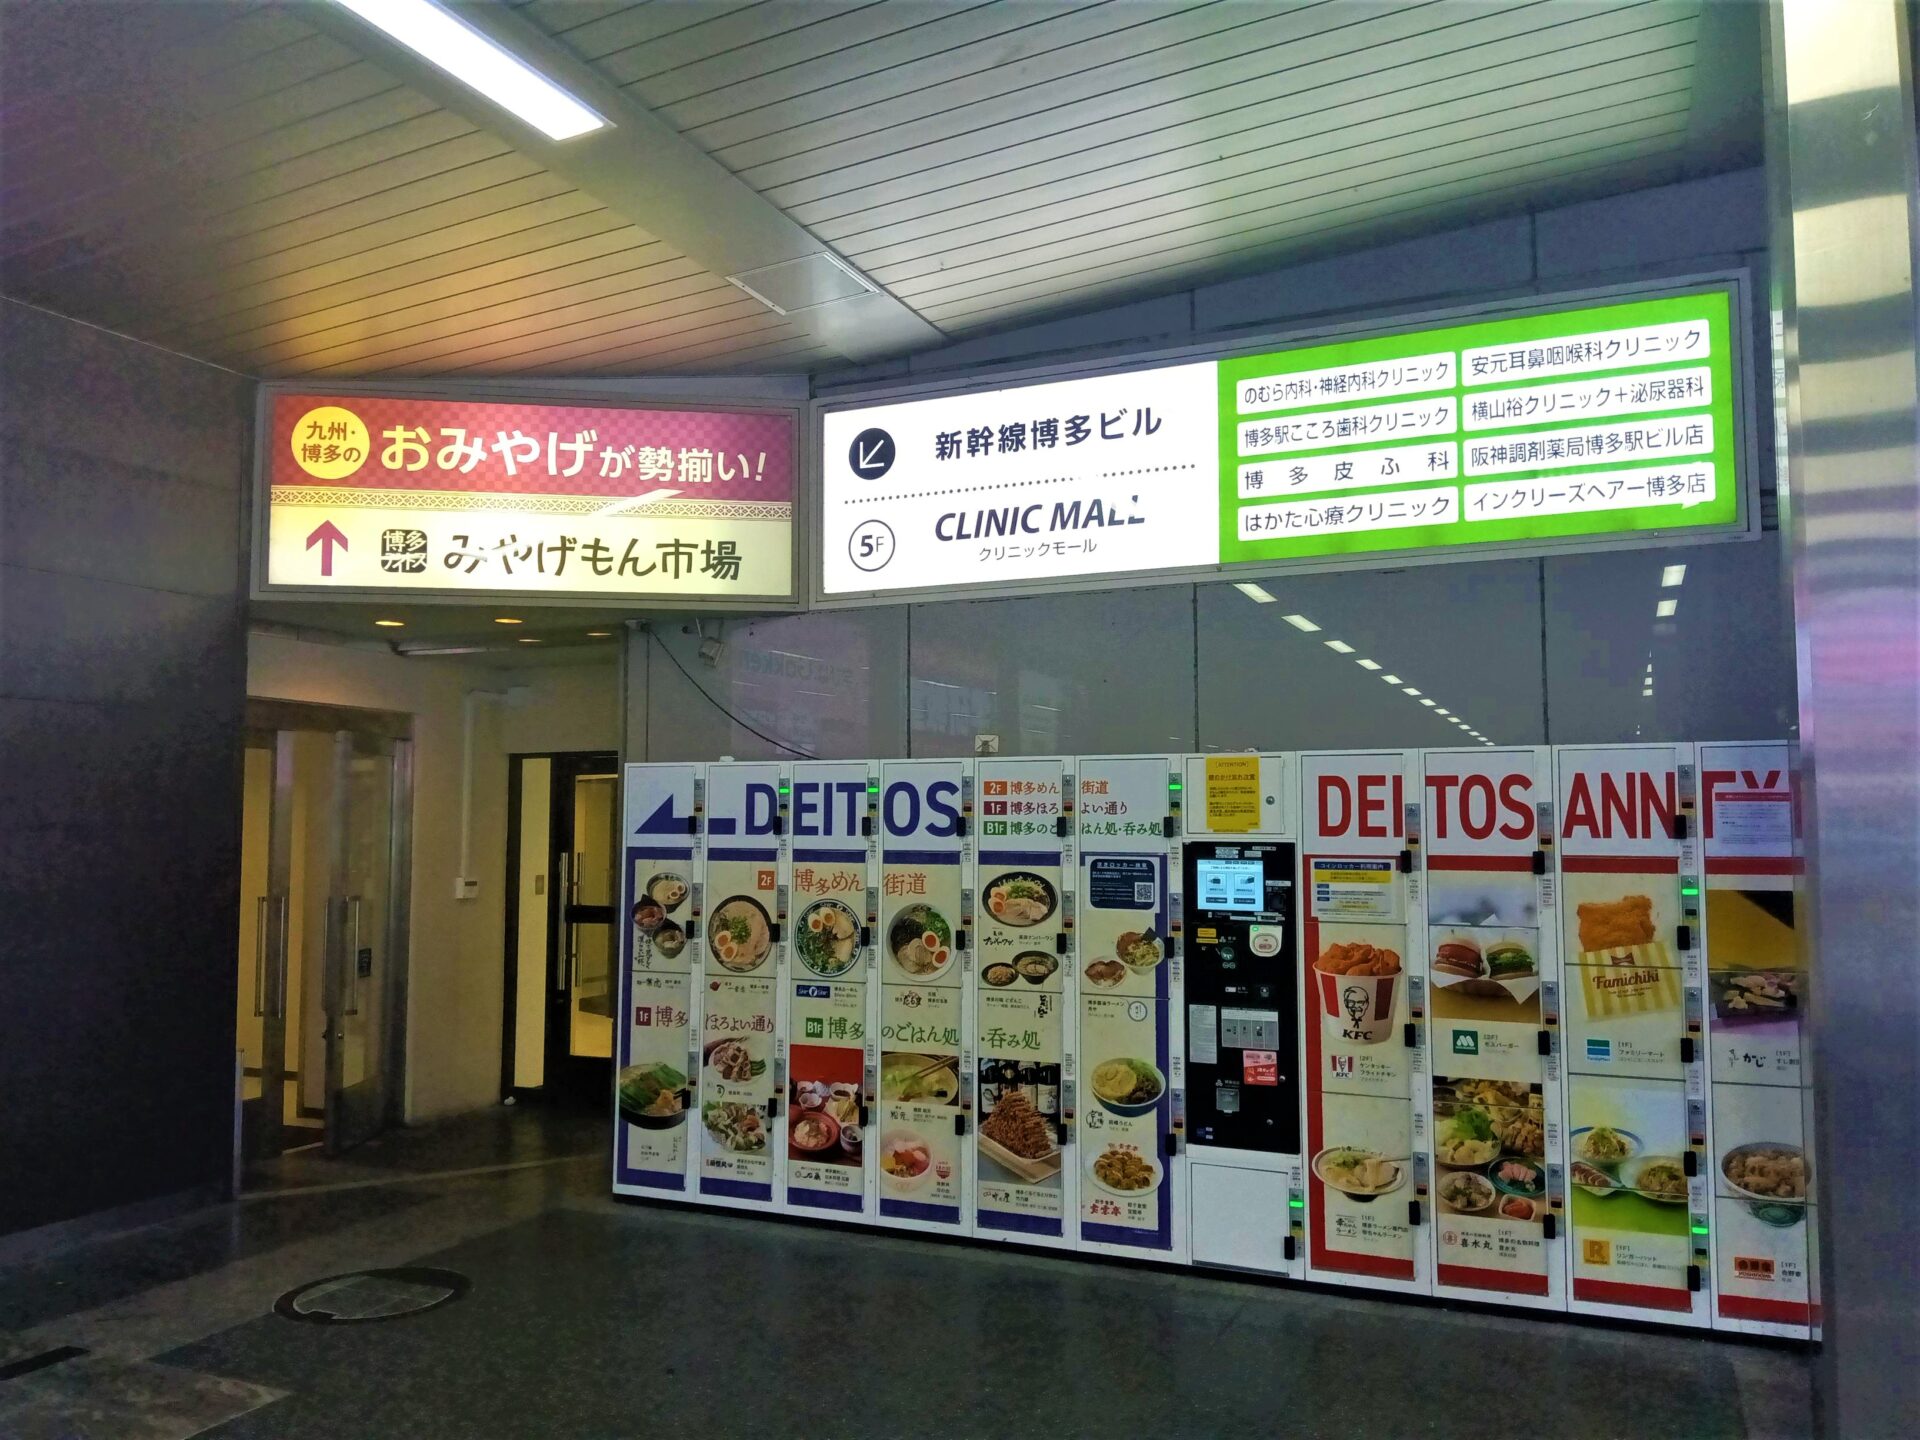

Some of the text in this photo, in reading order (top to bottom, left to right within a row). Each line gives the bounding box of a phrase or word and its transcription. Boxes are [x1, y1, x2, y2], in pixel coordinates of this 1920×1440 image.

[1471, 330, 1699, 376] 安元耳鼻咽喉科クリニック
[1245, 362, 1449, 405] のむら内科・神経内科クリニック
[935, 407, 1162, 461] 新幹線博多ビル
[1245, 406, 1449, 448] 博多駅こころ歯科クリニック
[301, 443, 361, 464] 博多の
[1471, 424, 1703, 467] 阪神調剤薬局博多駅ビル店
[1476, 473, 1705, 513] インクリーズヘアー博多店
[935, 504, 1043, 541] CLINIC
[1245, 496, 1449, 533] はかた心療クリニック
[383, 530, 427, 552] 博多
[860, 535, 884, 557] 5F
[979, 538, 1097, 562] クリニックモール
[444, 534, 742, 580] みやげもん市場
[990, 783, 1002, 793] 2F
[990, 803, 1002, 813] 1F
[985, 822, 1005, 834] B1F
[760, 874, 773, 887] 2F
[1592, 969, 1660, 990] Famichiki
[638, 1010, 650, 1022] 1F
[806, 1021, 823, 1035] B1F
[1342, 1029, 1373, 1041] KFC
[1618, 1049, 1665, 1058] ファミリーマート
[1616, 1253, 1657, 1262] リンガーハット
